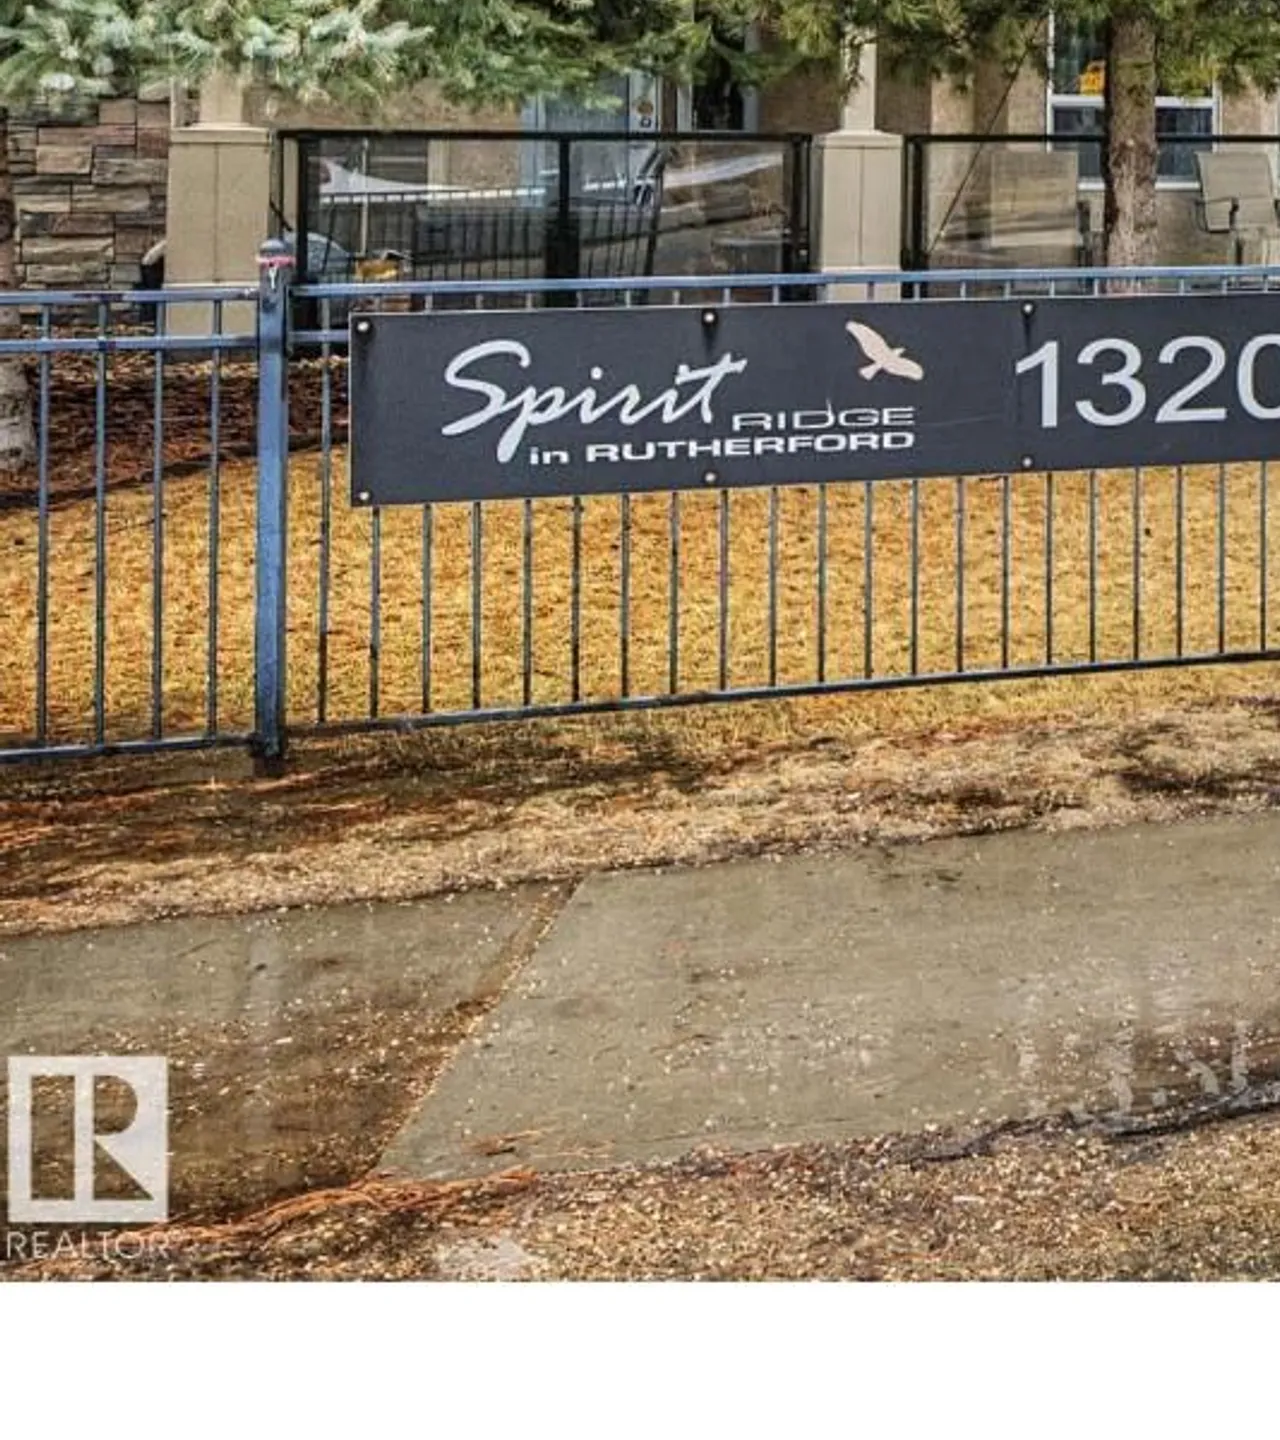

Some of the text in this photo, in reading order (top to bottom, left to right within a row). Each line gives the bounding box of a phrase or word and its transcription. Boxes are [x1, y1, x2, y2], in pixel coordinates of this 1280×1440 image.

[441, 339, 916, 463] Spirit RIDGE
[528, 431, 916, 466] in RUTHERFORD
